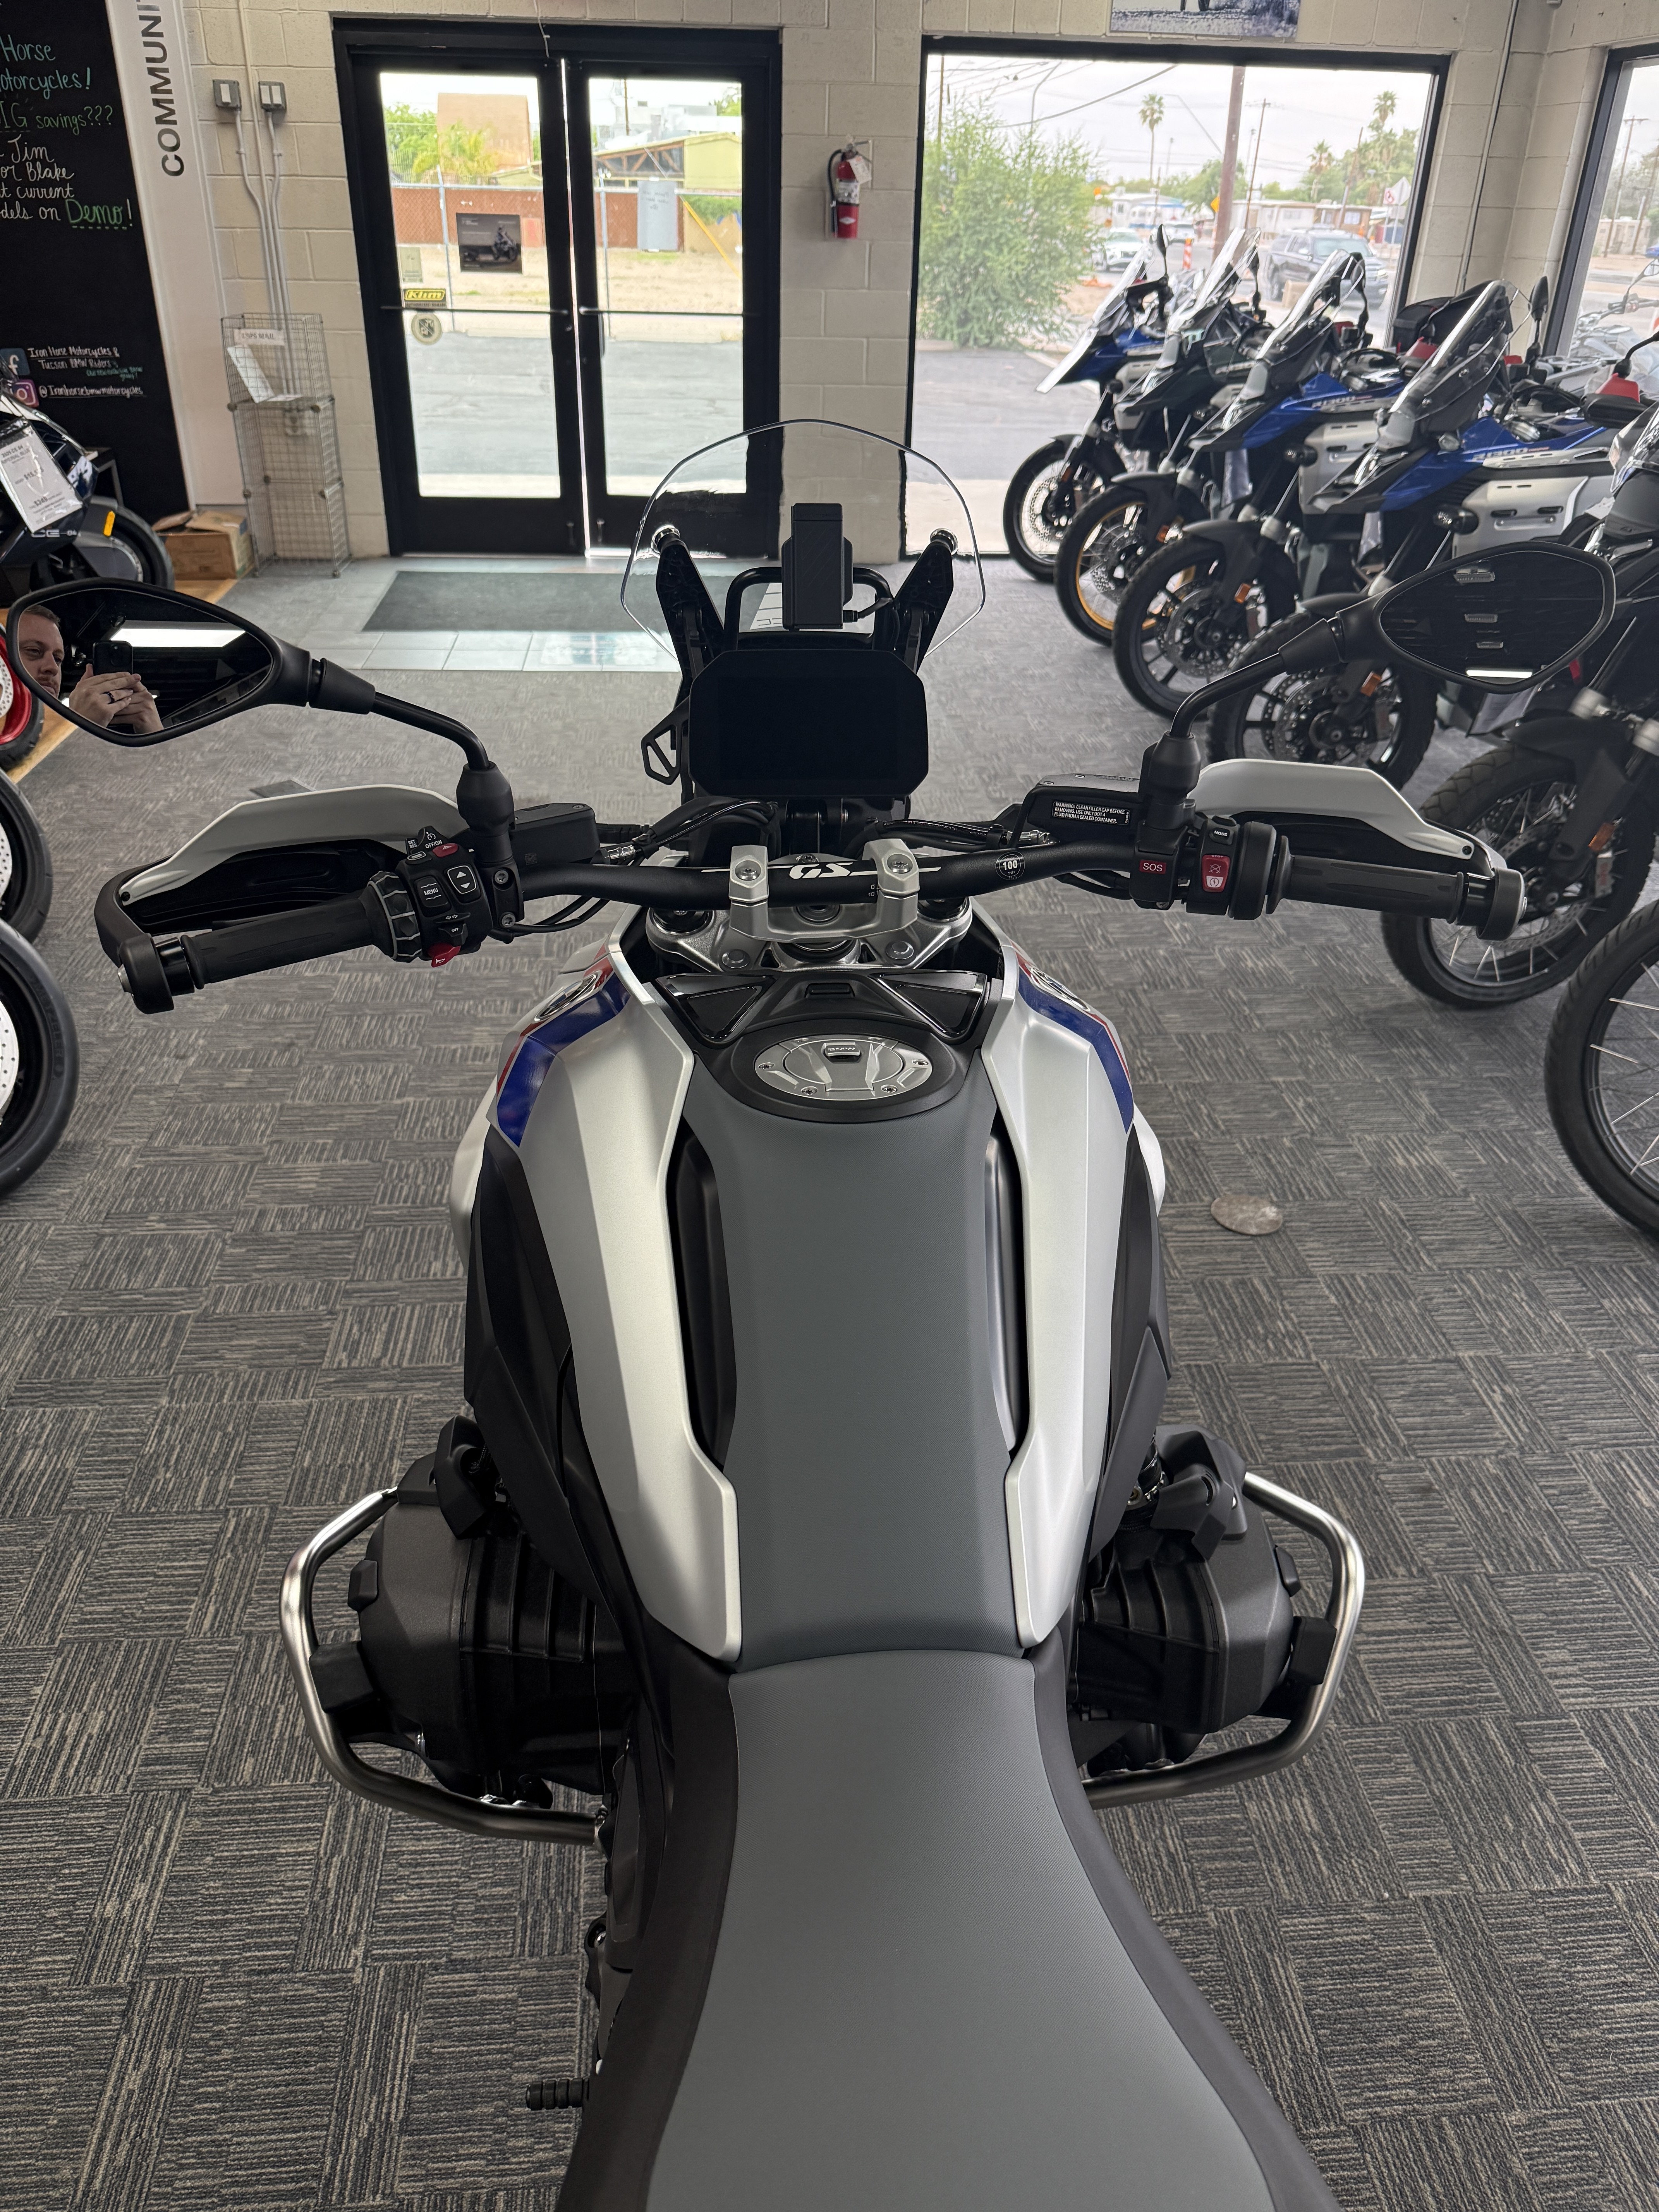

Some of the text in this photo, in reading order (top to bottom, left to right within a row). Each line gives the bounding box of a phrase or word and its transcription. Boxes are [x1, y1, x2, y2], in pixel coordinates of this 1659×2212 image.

[0, 34, 56, 62] Horse
[0, 67, 90, 99] otorcycles!
[136, 0, 184, 177] COMMUNI
[0, 101, 28, 128] IG
[8, 134, 55, 163] Jim
[0, 161, 74, 181] or Blake
[16, 183, 75, 199] current
[0, 201, 33, 220] dels
[39, 206, 61, 221] on
[425, 840, 443, 849] OFF/ON
[789, 863, 851, 879] GS
[1003, 860, 1018, 870] 100
[1143, 862, 1163, 872] SOS
[424, 888, 438, 896] MENU
